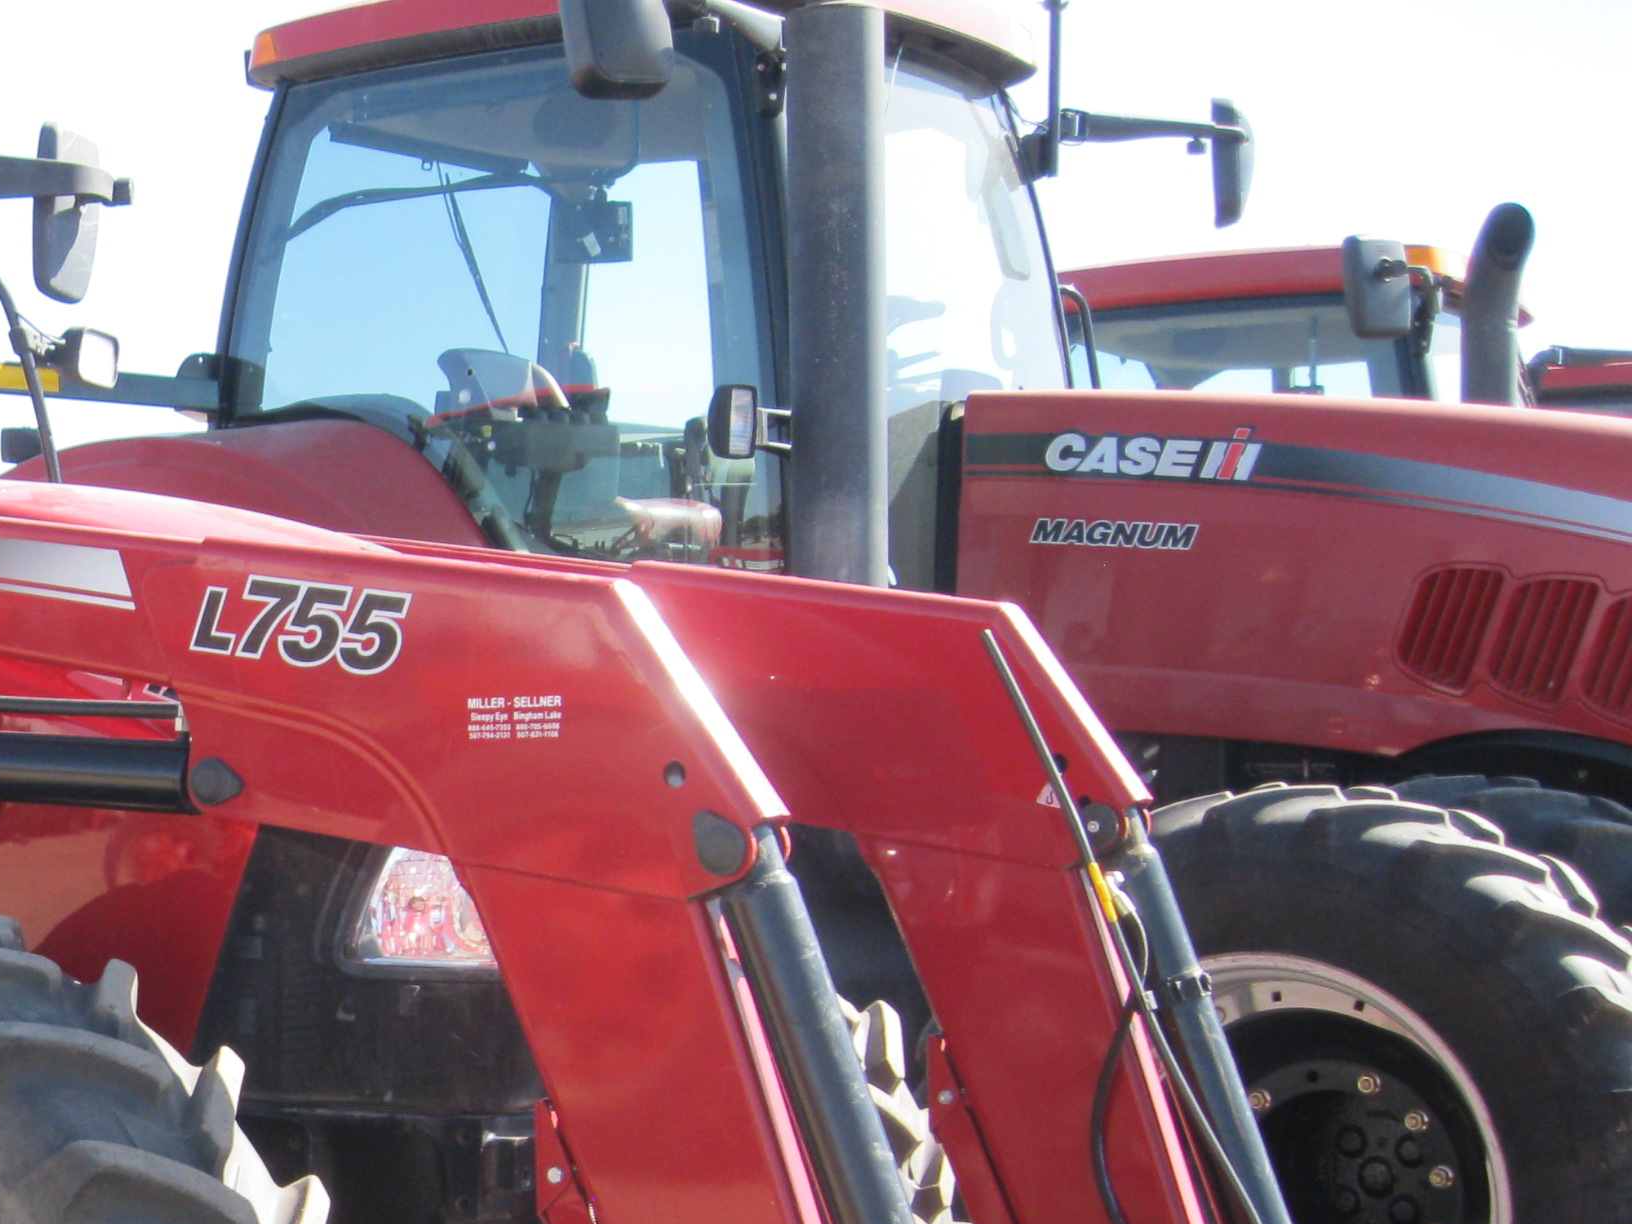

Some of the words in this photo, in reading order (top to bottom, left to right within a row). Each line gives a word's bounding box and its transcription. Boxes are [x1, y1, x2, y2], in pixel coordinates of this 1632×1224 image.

[1029, 517, 1200, 551] MAGNUM
[188, 573, 413, 676] L755
[467, 697, 505, 709] MILLER
[513, 695, 562, 708] SELLNER
[470, 712, 494, 722] Sleepy
[495, 712, 508, 722] Eye
[513, 711, 544, 722] Bingham
[544, 711, 562, 720] Lake
